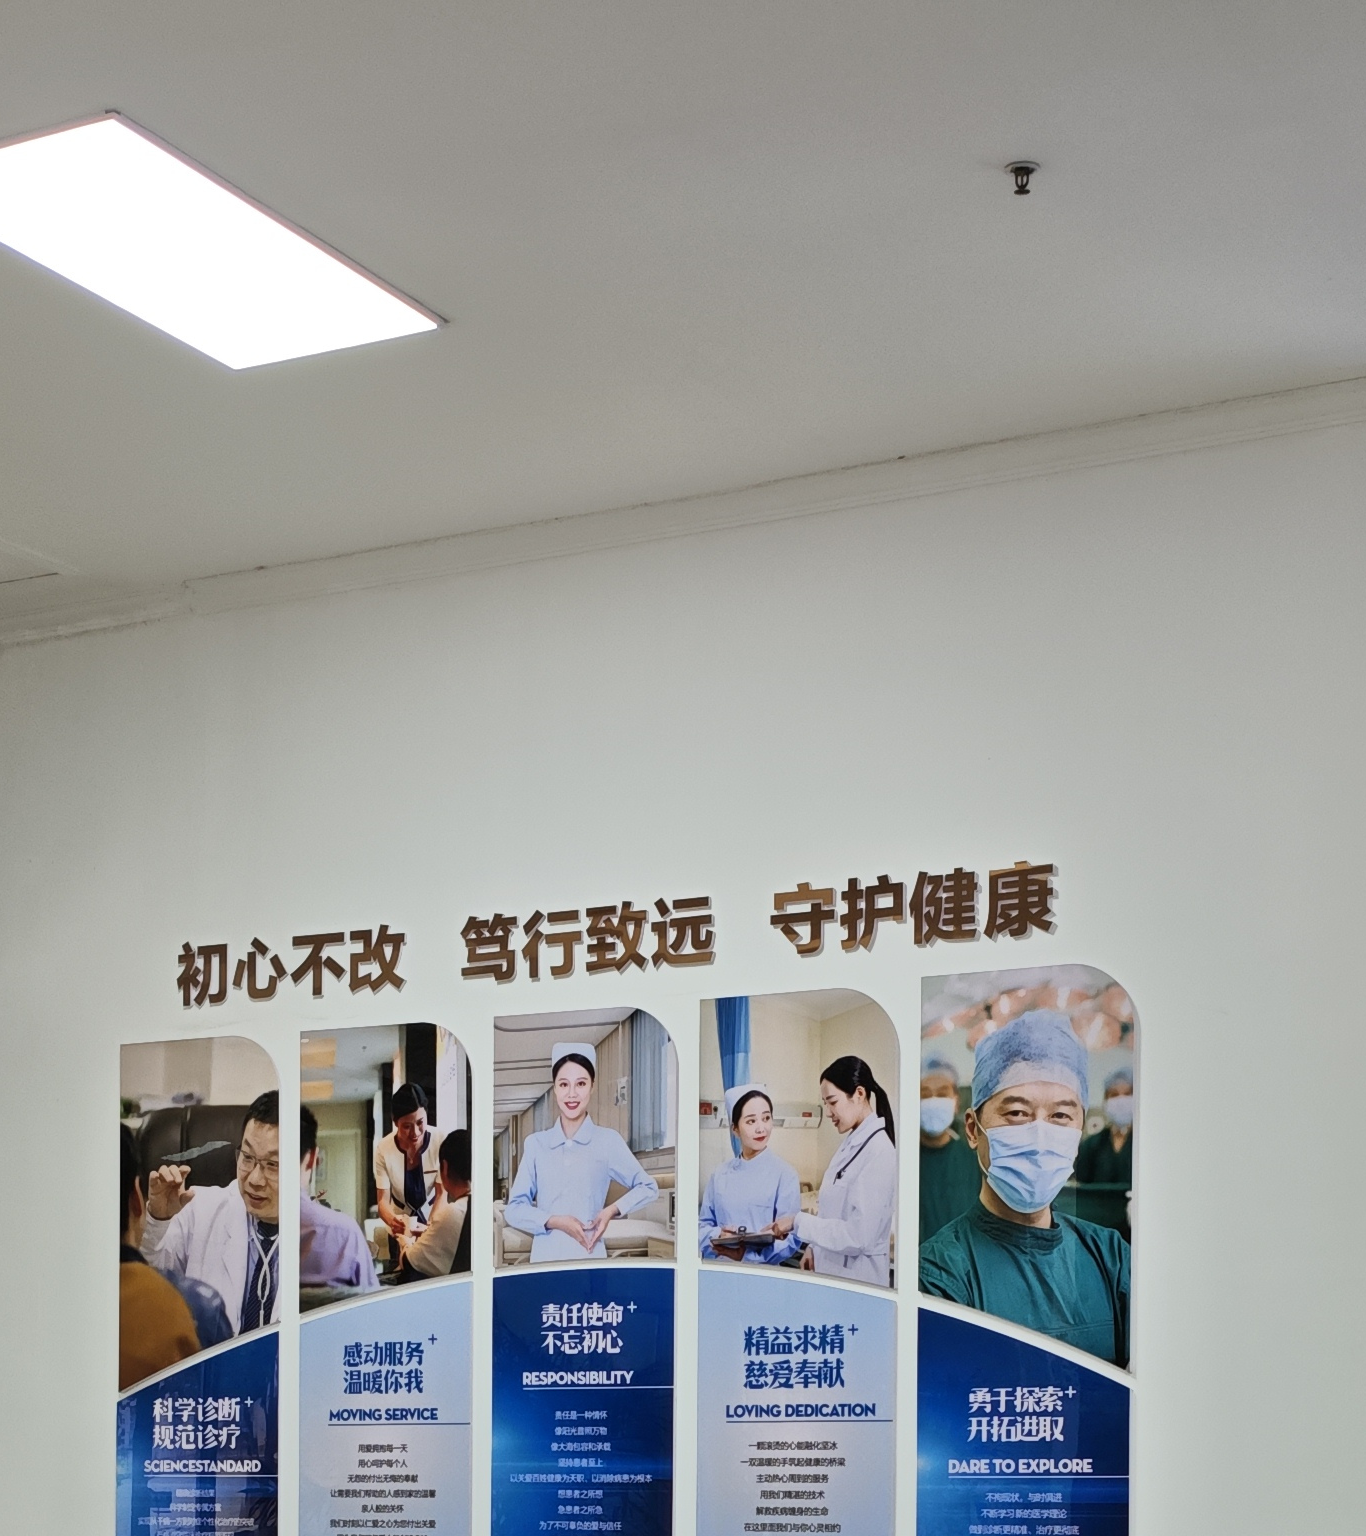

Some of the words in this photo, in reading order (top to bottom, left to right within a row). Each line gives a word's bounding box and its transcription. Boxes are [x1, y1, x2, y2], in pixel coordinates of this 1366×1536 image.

[175, 924, 407, 1007] 初心不改
[459, 896, 717, 982] 笃行致远
[769, 860, 1060, 955] 守护健康
[541, 1302, 624, 1328] 责任使命
[541, 1329, 623, 1355] 不忘初心
[744, 1324, 845, 1356] 精益求精
[343, 1341, 424, 1367] 感动服务
[343, 1369, 424, 1394] 温暖你我
[523, 1370, 634, 1385] RESPONSIBILITY
[744, 1358, 845, 1389] 慈爱奉献
[153, 1397, 241, 1422] 科学诊断
[726, 1404, 782, 1418] LOVING
[785, 1403, 876, 1418] DEDICATION
[968, 1386, 1064, 1414] 勇于探索
[329, 1409, 382, 1421] MOVING
[385, 1408, 438, 1421] SERVICE
[153, 1425, 241, 1450] 规范诊疗
[967, 1416, 1064, 1442] 开拓进取
[144, 1460, 261, 1473] SCIENCESTANDARD
[358, 1459, 408, 1468] 用心呵护每个人
[948, 1459, 990, 1474] DARE
[993, 1459, 1014, 1473] TO
[1018, 1458, 1093, 1473] EXPLORE
